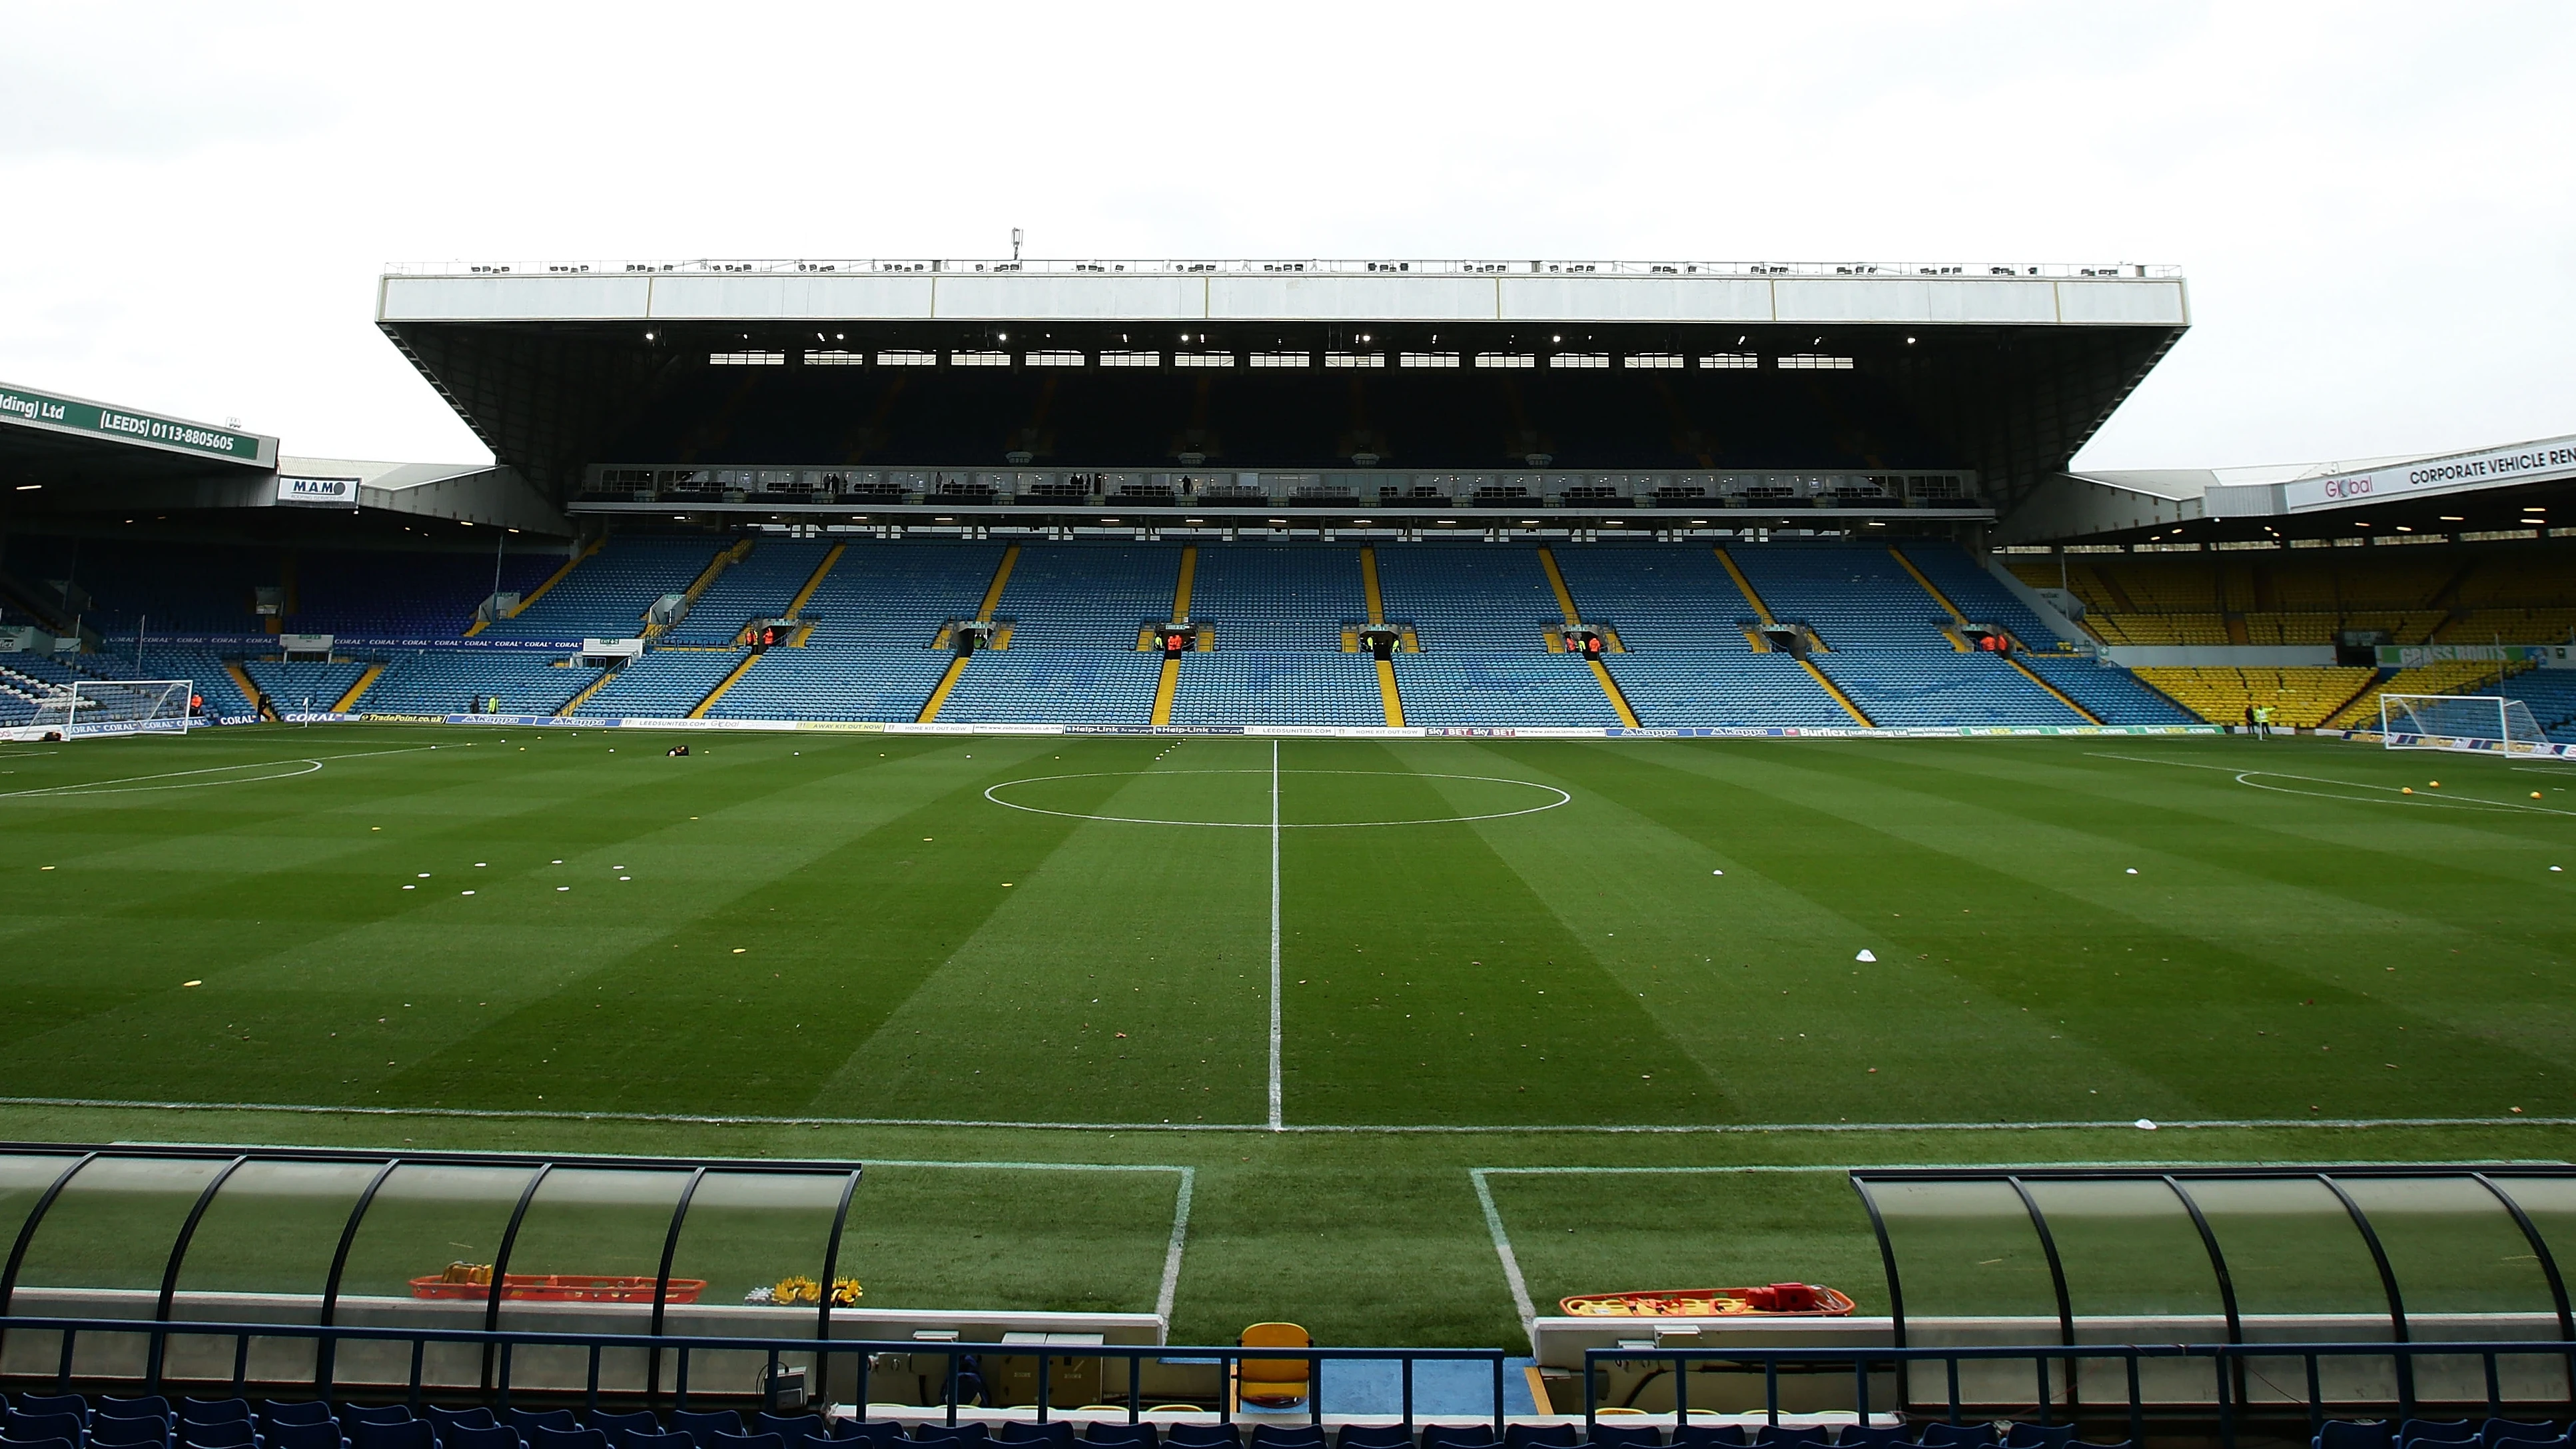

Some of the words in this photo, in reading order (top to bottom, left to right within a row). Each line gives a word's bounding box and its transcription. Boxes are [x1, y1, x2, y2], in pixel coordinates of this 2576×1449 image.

[41, 402, 65, 419] Ltd
[100, 410, 150, 436] (LEEDS)
[152, 421, 234, 450] 0113-8805605
[2410, 462, 2487, 484] CORPORATE
[2488, 452, 2546, 474] VEHICLE
[2326, 475, 2373, 498] Global
[220, 716, 254, 725] CORAL
[370, 714, 443, 723] TradePoint.co.uk
[477, 716, 519, 724] Kappa
[565, 718, 606, 726] Kappa
[1427, 727, 1445, 736] sky
[1472, 727, 1490, 736] sky
